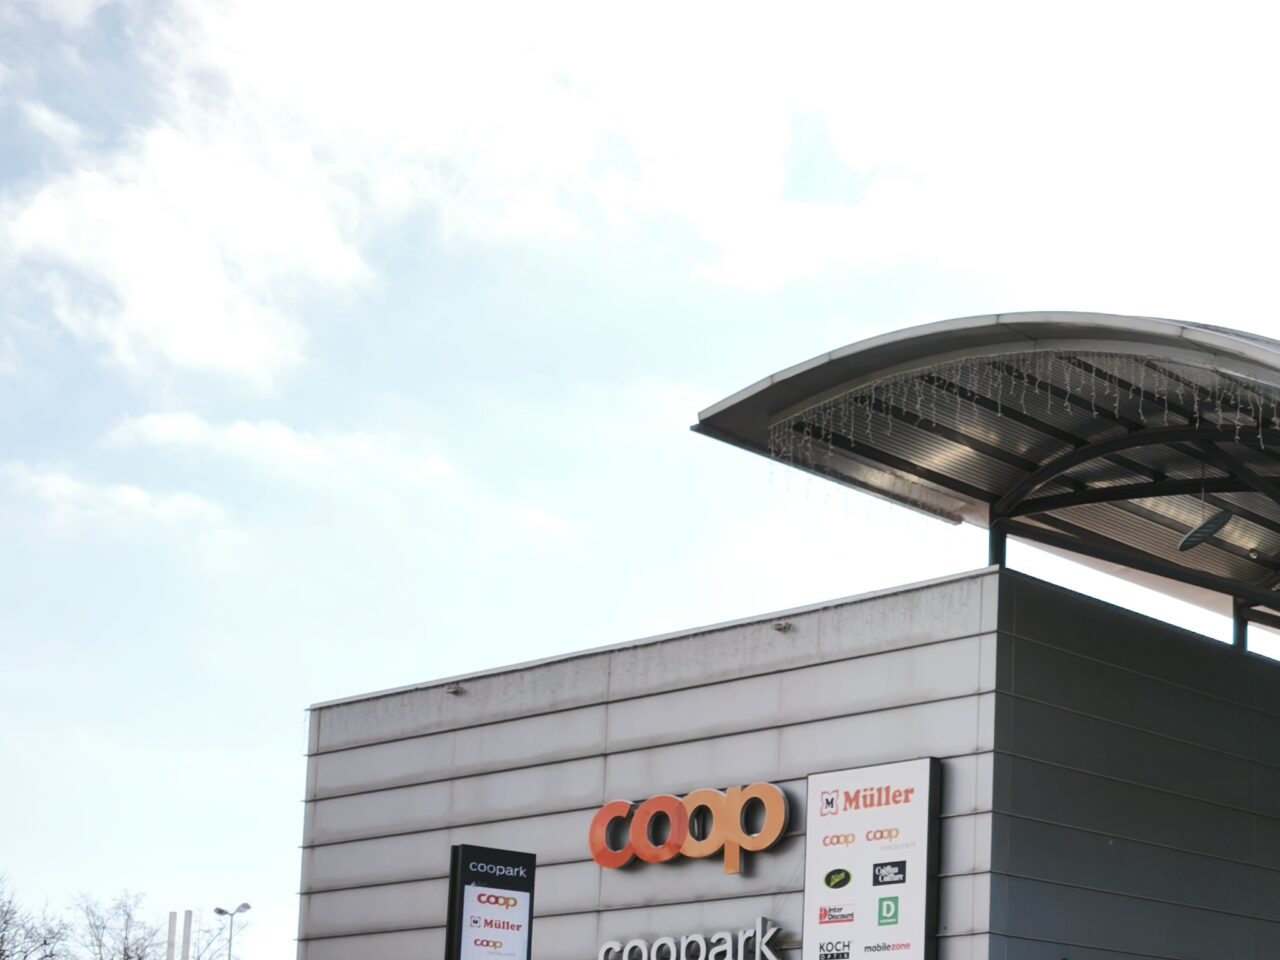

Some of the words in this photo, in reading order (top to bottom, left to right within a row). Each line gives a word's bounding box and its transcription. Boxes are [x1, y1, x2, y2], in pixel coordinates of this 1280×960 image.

[843, 785, 914, 812] Müller
[589, 782, 786, 875] coop
[866, 828, 900, 842] coop
[822, 833, 855, 847] coop
[469, 861, 527, 878] coopark
[477, 892, 518, 909] coop
[484, 918, 522, 932] Müller
[474, 938, 503, 950] coop
[819, 941, 851, 953] KOCH
[864, 942, 911, 953] mobilezone
